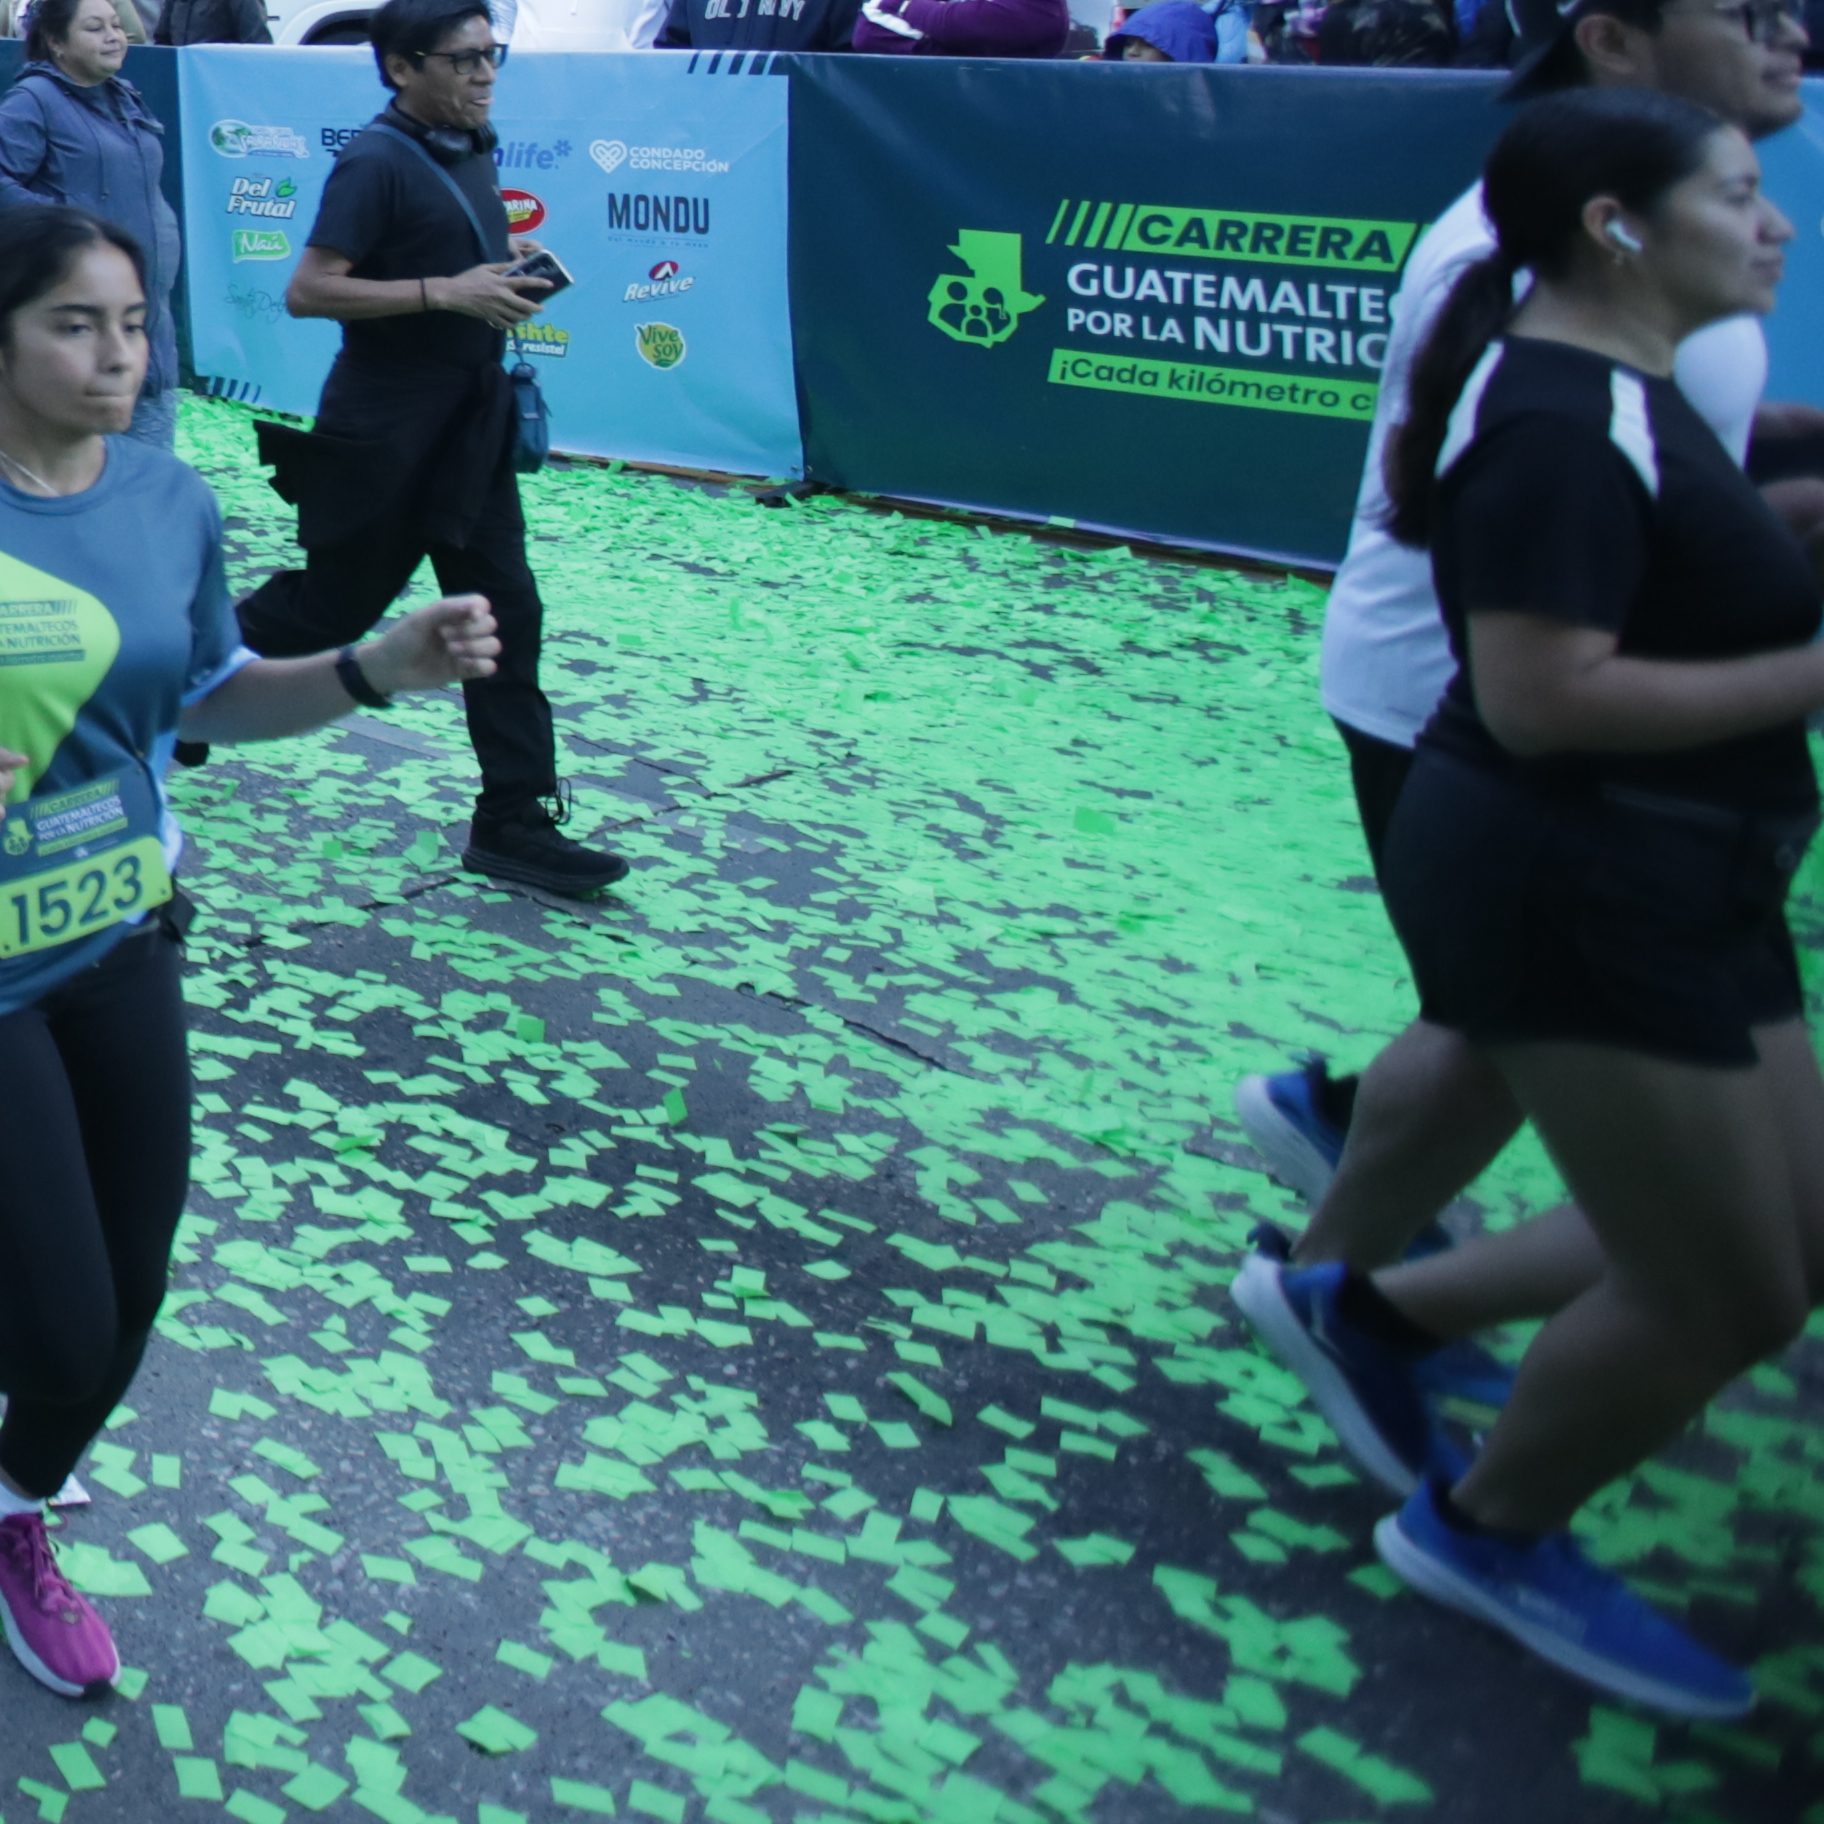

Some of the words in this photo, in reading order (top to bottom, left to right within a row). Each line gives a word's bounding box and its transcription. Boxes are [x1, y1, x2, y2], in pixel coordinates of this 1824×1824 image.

[629, 146, 706, 161] CONDADO
[629, 158, 729, 173] CONCEPCIÓN
[226, 194, 297, 219] Frutal
[231, 176, 273, 198] Del
[607, 192, 710, 236] MONDU
[1137, 213, 1395, 264] CARRERA
[622, 275, 695, 303] Revive
[1066, 307, 1134, 340] POR
[1141, 315, 1186, 344] LA
[1193, 316, 1390, 369] NUTRIC
[1058, 357, 1160, 388] ¡Cada
[1167, 367, 1341, 409] kilómetro
[11, 855, 143, 945] 1523
